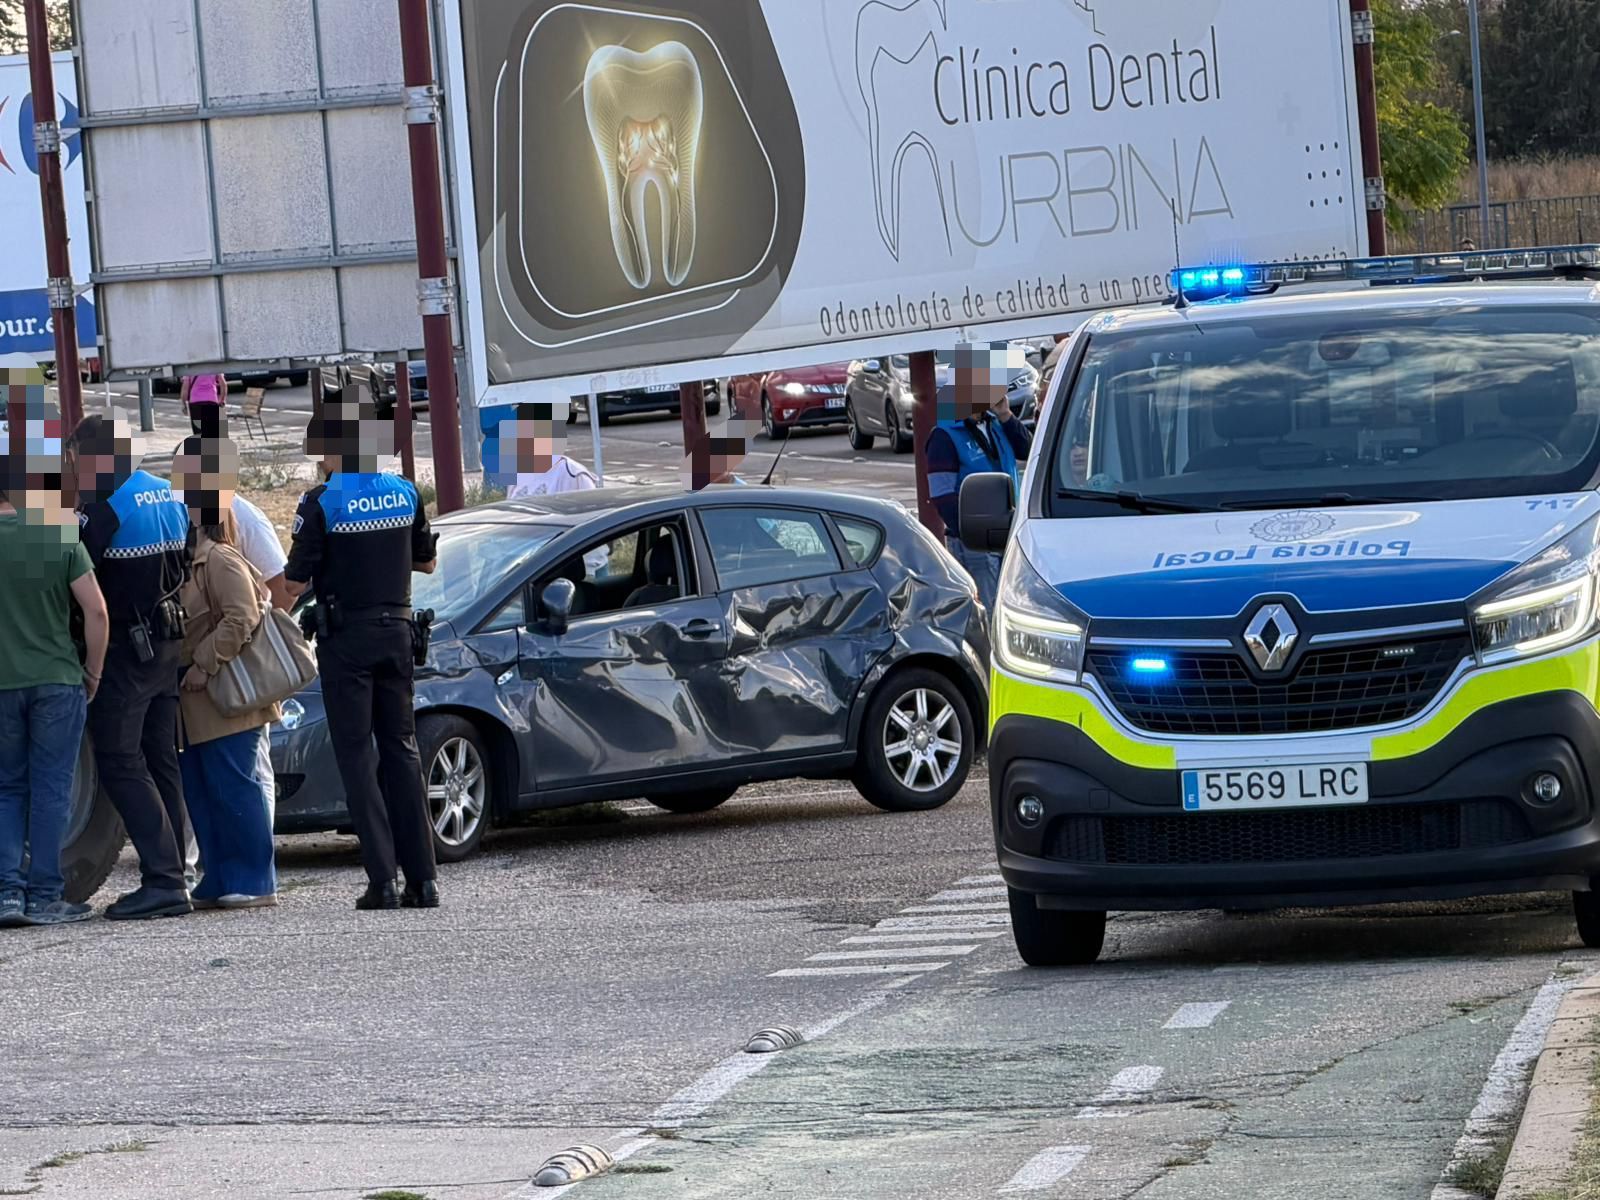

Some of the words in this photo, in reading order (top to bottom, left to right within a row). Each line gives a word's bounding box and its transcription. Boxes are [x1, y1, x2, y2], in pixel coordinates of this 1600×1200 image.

[933, 46, 1070, 126] Clínica
[1088, 25, 1221, 112] Dental
[950, 135, 1234, 248] URBINA
[820, 291, 952, 336] Odontología
[962, 285, 986, 319] de
[995, 273, 1070, 314] calidad
[1079, 282, 1090, 304] a
[1099, 278, 1123, 302] un
[134, 485, 174, 507] POLICÍ
[347, 490, 409, 514] POLICÍA
[1525, 498, 1577, 511] 717
[1205, 770, 1286, 802] 5569
[1298, 766, 1359, 798] LRC
